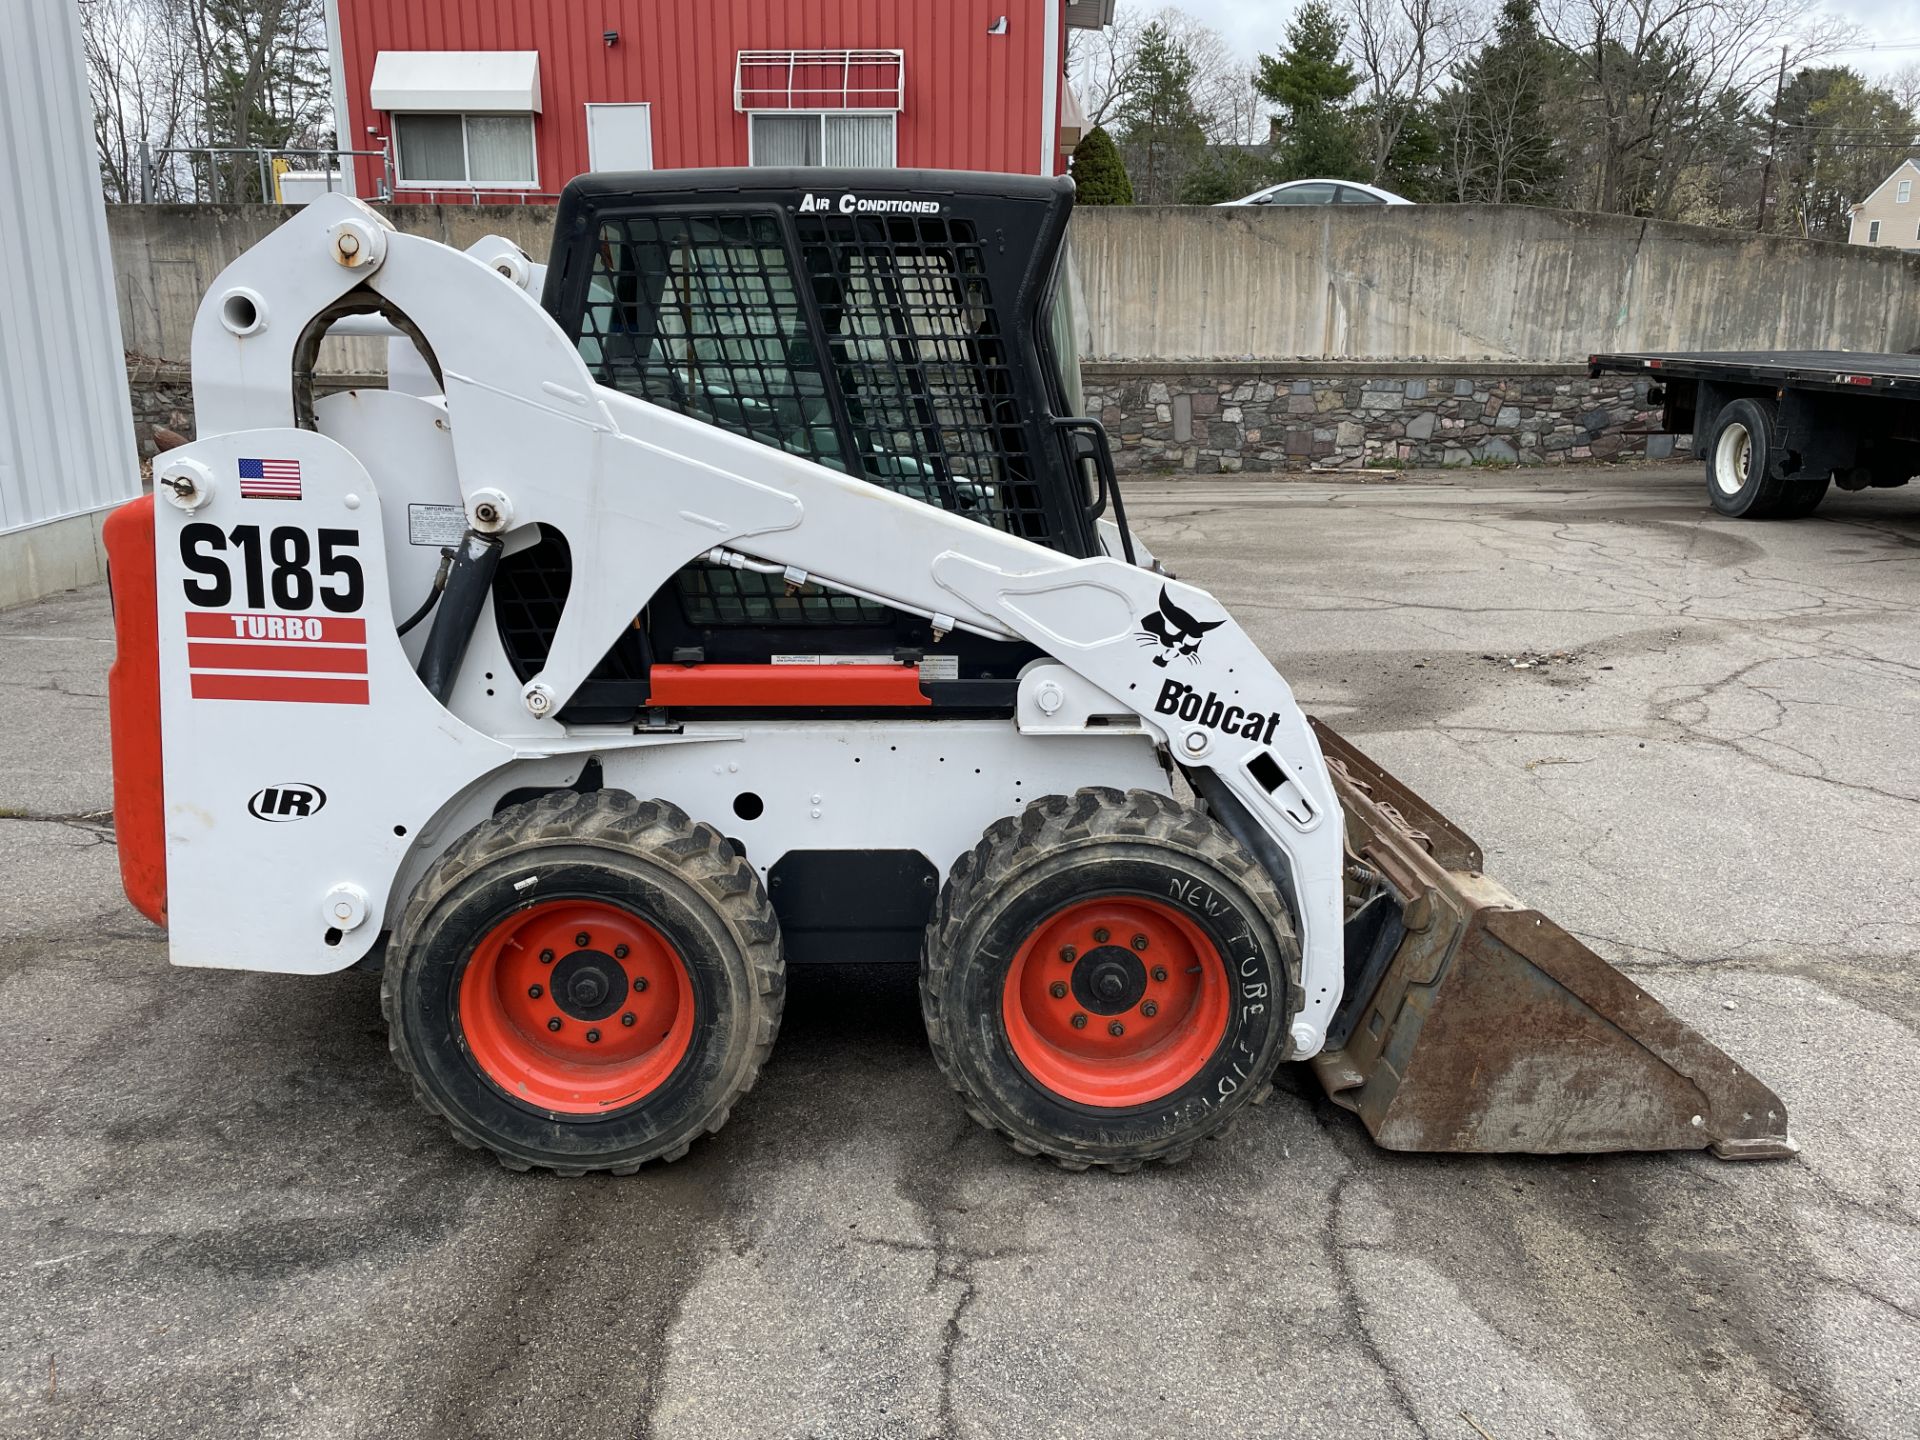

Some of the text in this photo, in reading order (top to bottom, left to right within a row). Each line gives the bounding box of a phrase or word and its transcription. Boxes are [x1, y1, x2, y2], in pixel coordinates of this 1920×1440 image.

[179, 522, 365, 613] S185
[231, 615, 323, 640] TURBO
[1154, 678, 1281, 745] Bobcat
[260, 788, 314, 817] IR
[1168, 878, 1231, 917] NEW
